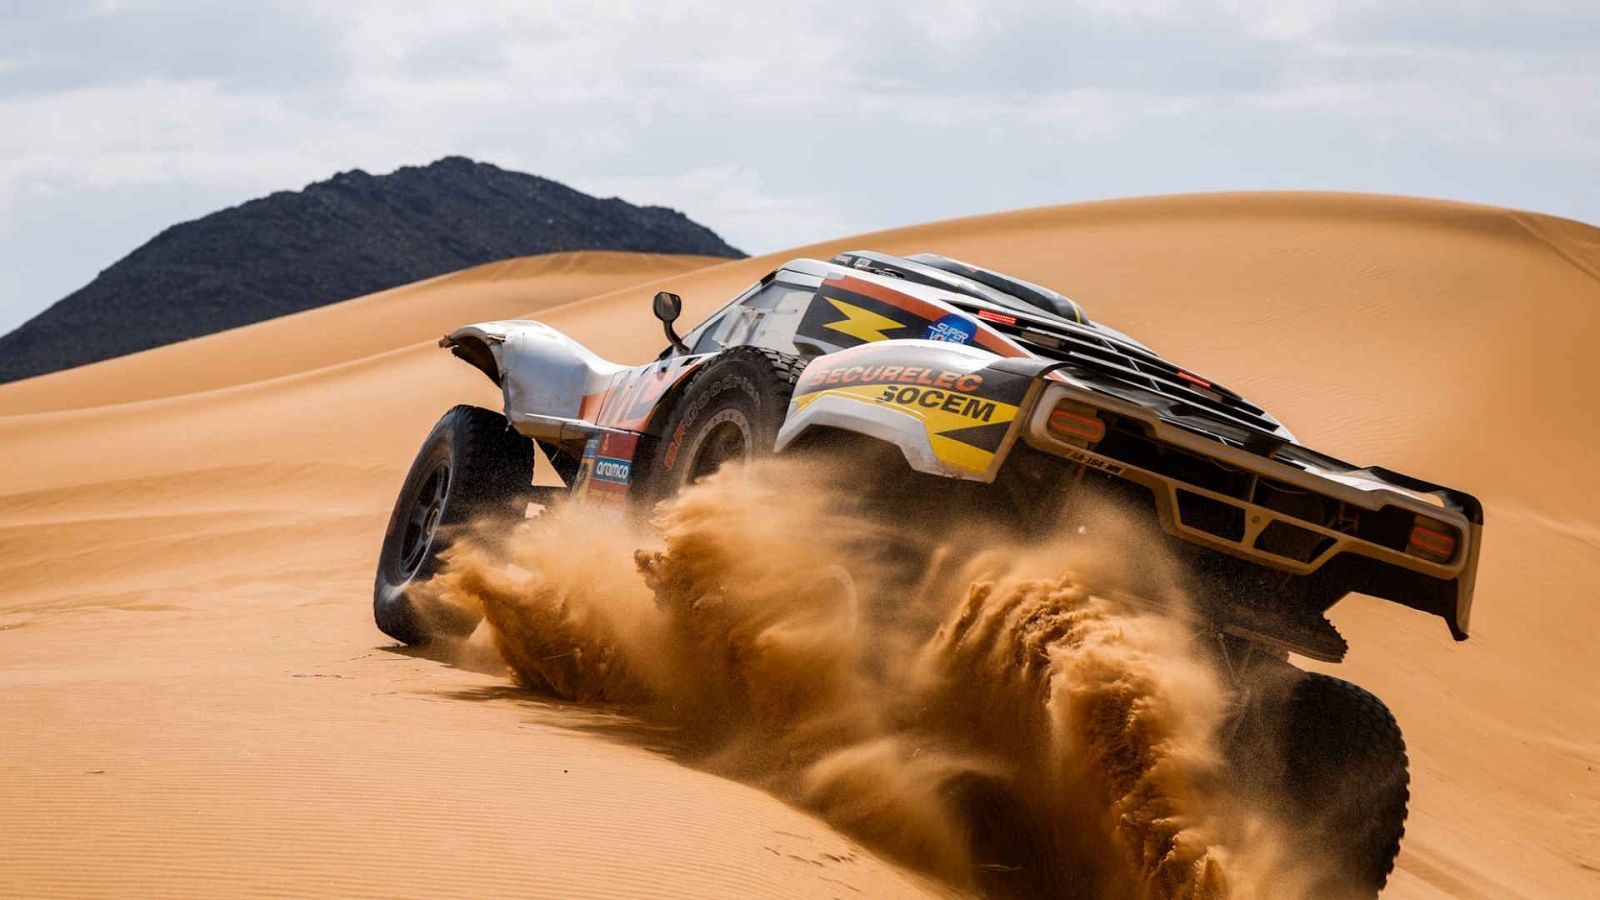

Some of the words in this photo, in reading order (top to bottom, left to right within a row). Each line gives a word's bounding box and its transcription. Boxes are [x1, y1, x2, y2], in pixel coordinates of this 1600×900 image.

[928, 322, 969, 344] SUPER
[809, 364, 984, 392] SECURELEC
[875, 385, 997, 423] SOCEM
[596, 460, 629, 479] aramco
